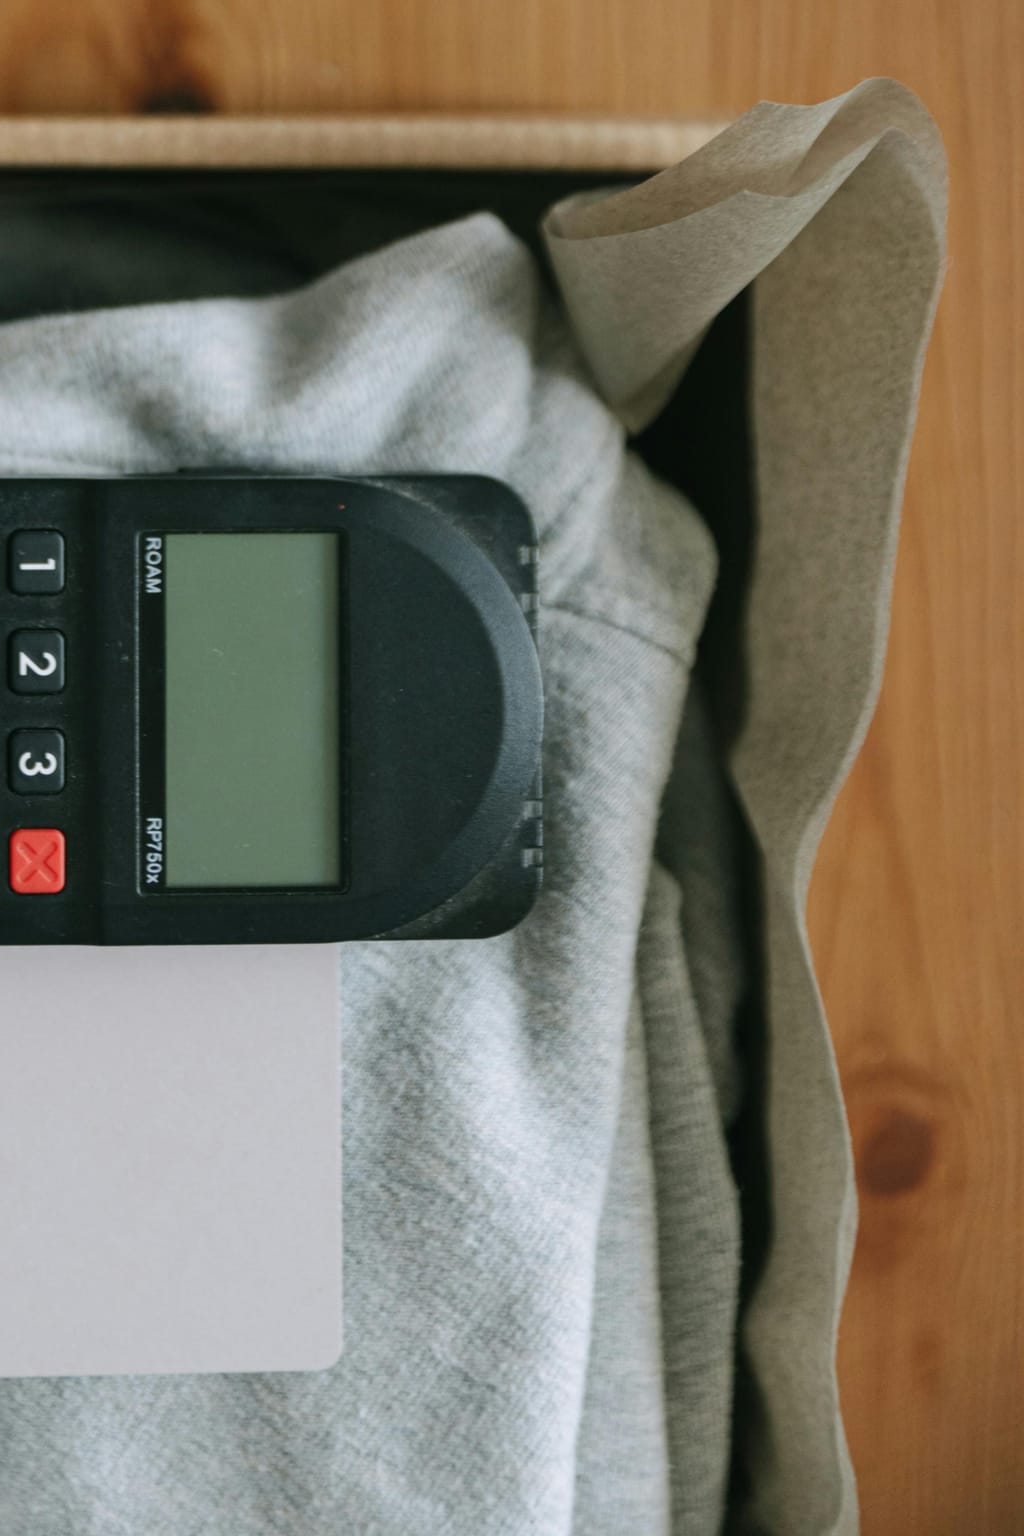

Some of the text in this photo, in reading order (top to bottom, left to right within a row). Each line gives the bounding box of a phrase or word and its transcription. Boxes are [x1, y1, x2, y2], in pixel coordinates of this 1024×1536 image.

[19, 558, 56, 571] 1
[146, 537, 162, 593] ROAM
[19, 651, 57, 677] 2
[18, 751, 58, 777] 3
[146, 817, 162, 884] RP750x
